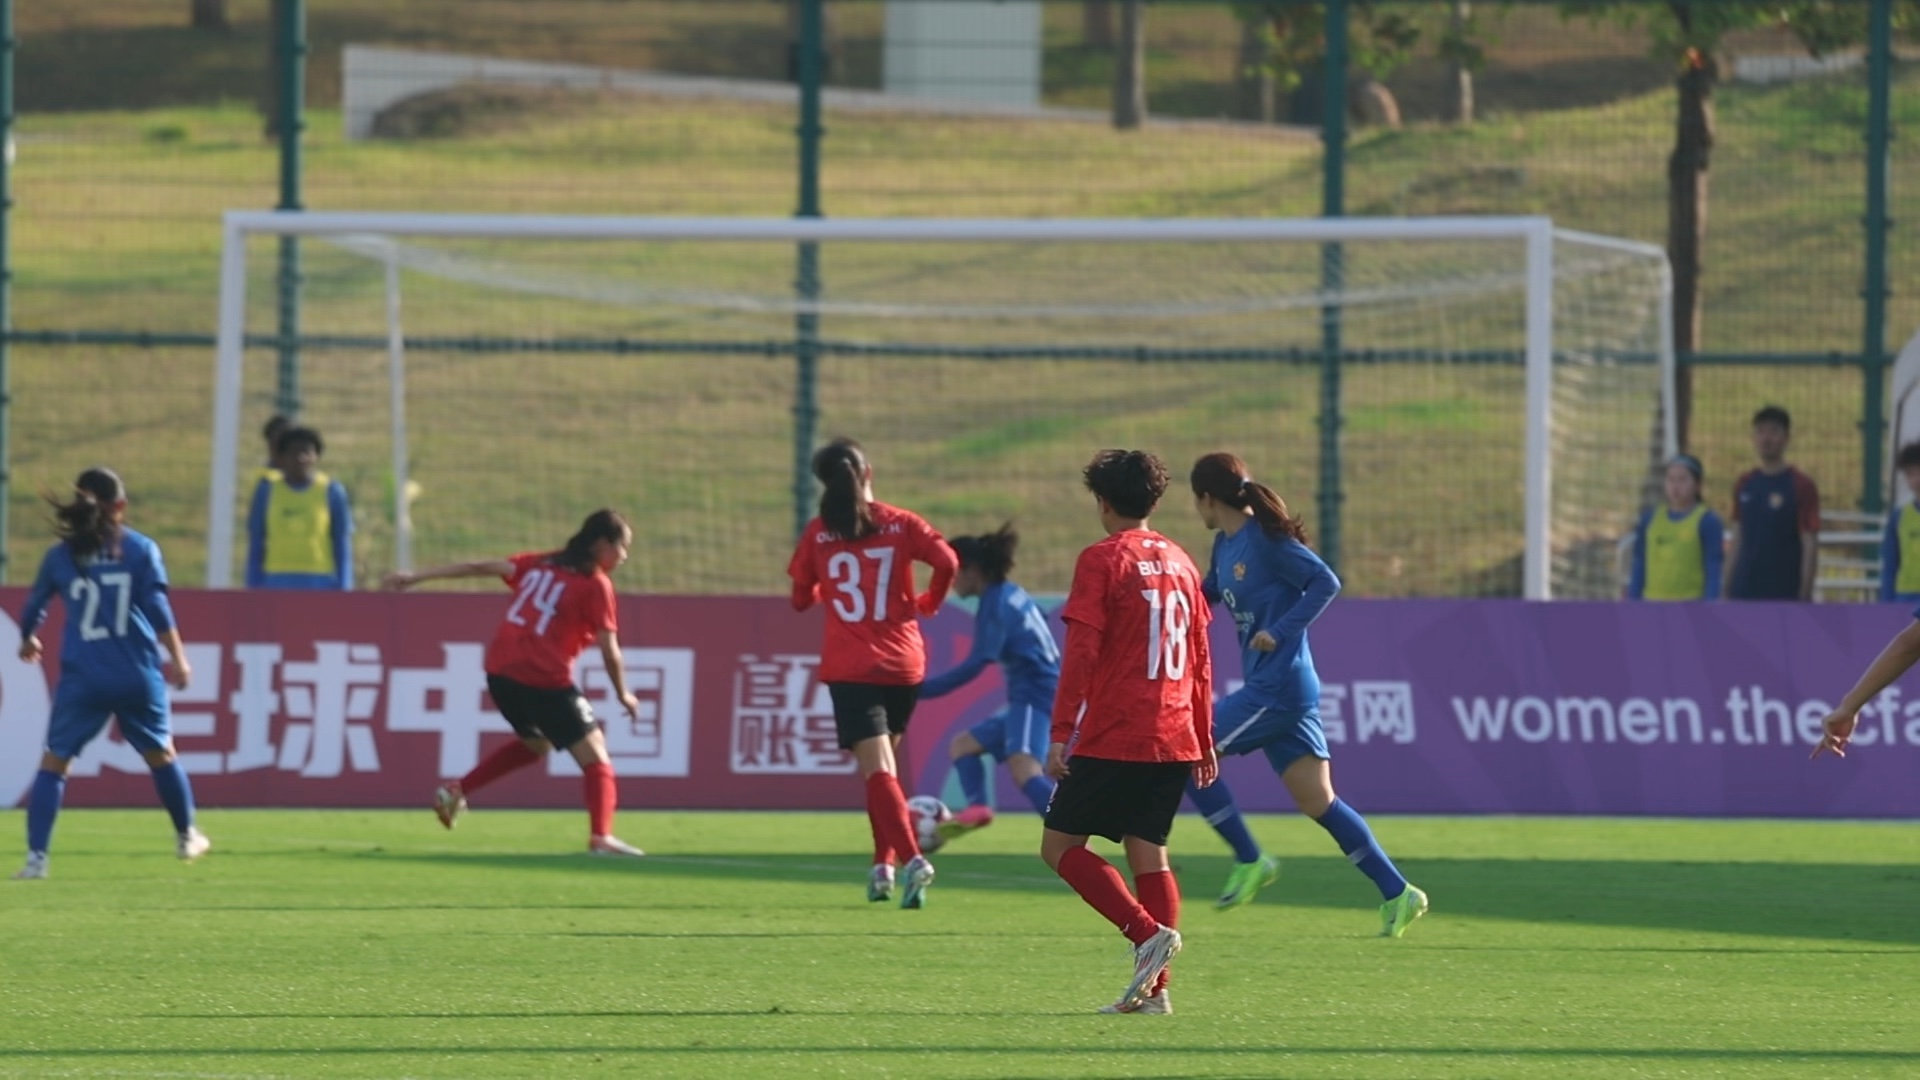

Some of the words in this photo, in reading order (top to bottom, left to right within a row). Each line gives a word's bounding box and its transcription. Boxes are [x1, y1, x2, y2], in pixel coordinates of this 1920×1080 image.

[69, 572, 132, 642] 27
[507, 567, 566, 636] 24
[827, 546, 895, 622] 37
[1140, 588, 1190, 681] 18
[66, 641, 694, 778] 足球中国
